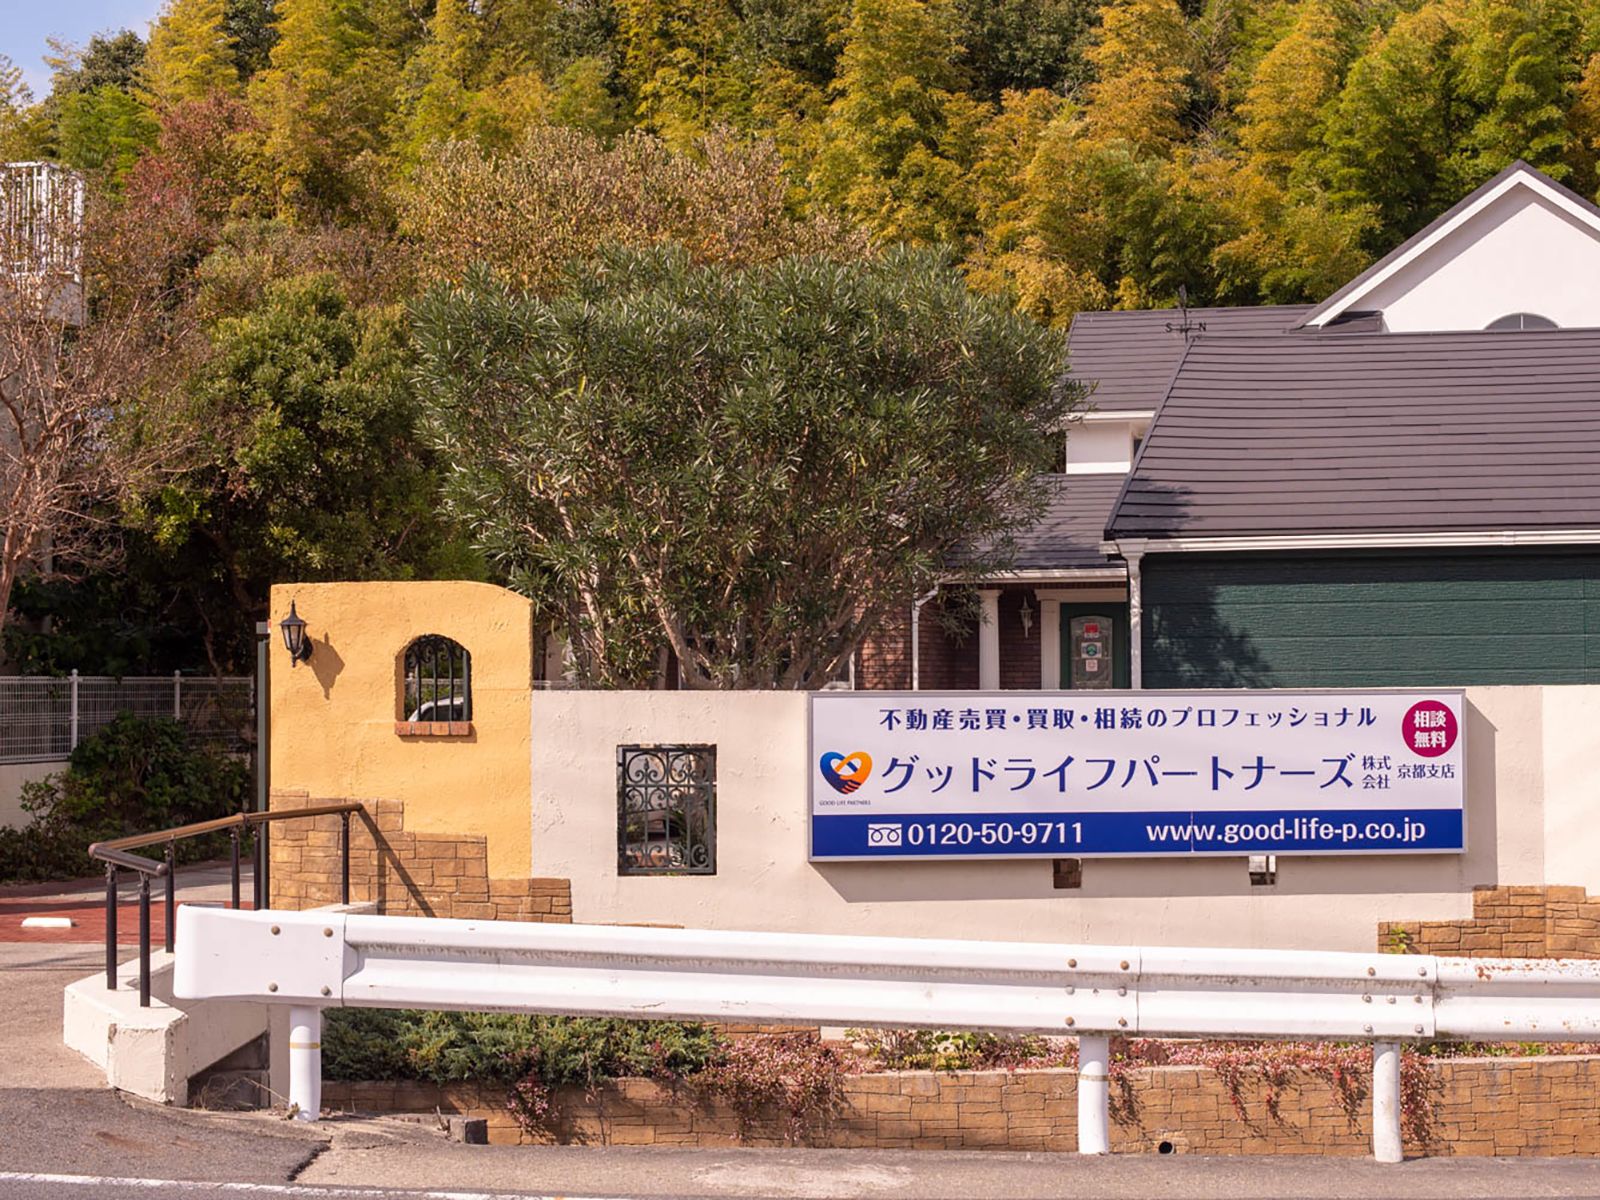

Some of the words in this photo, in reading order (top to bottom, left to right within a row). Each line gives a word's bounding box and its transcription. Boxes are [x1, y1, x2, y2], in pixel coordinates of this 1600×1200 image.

[879, 707, 1377, 730] 不動産売買・買取・相続のプロフェッショナル
[1413, 709, 1447, 728] 相談
[1413, 731, 1447, 748] 無料
[882, 754, 1355, 793] グッドライフパートナーズ
[1396, 763, 1455, 780] 京都支店
[908, 823, 1082, 844] 0120-50-9711
[1146, 817, 1426, 842] www.good-life-p.co.jp
